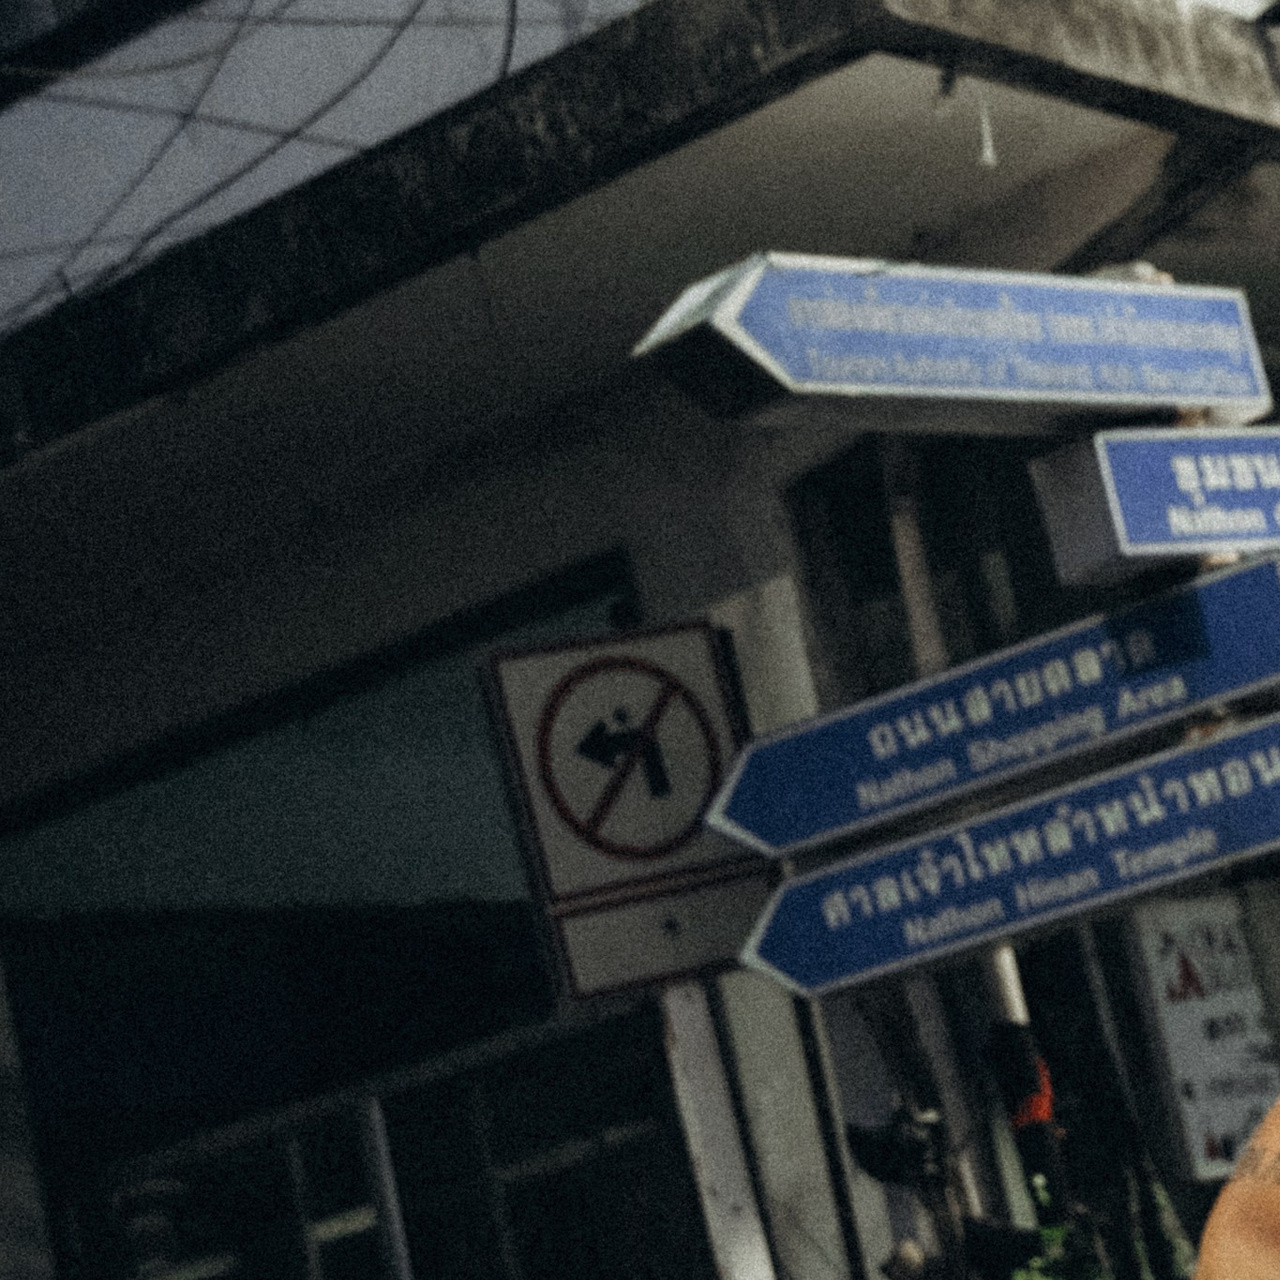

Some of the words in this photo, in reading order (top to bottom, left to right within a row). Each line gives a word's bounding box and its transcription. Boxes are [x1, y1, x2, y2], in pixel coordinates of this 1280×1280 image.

[1166, 504, 1267, 537] Nathon
[857, 756, 958, 810] Nathon
[968, 715, 1104, 773] Shopping
[1115, 675, 1189, 718] Area
[904, 897, 1004, 946] Nathon
[1115, 825, 1219, 880] Temple
